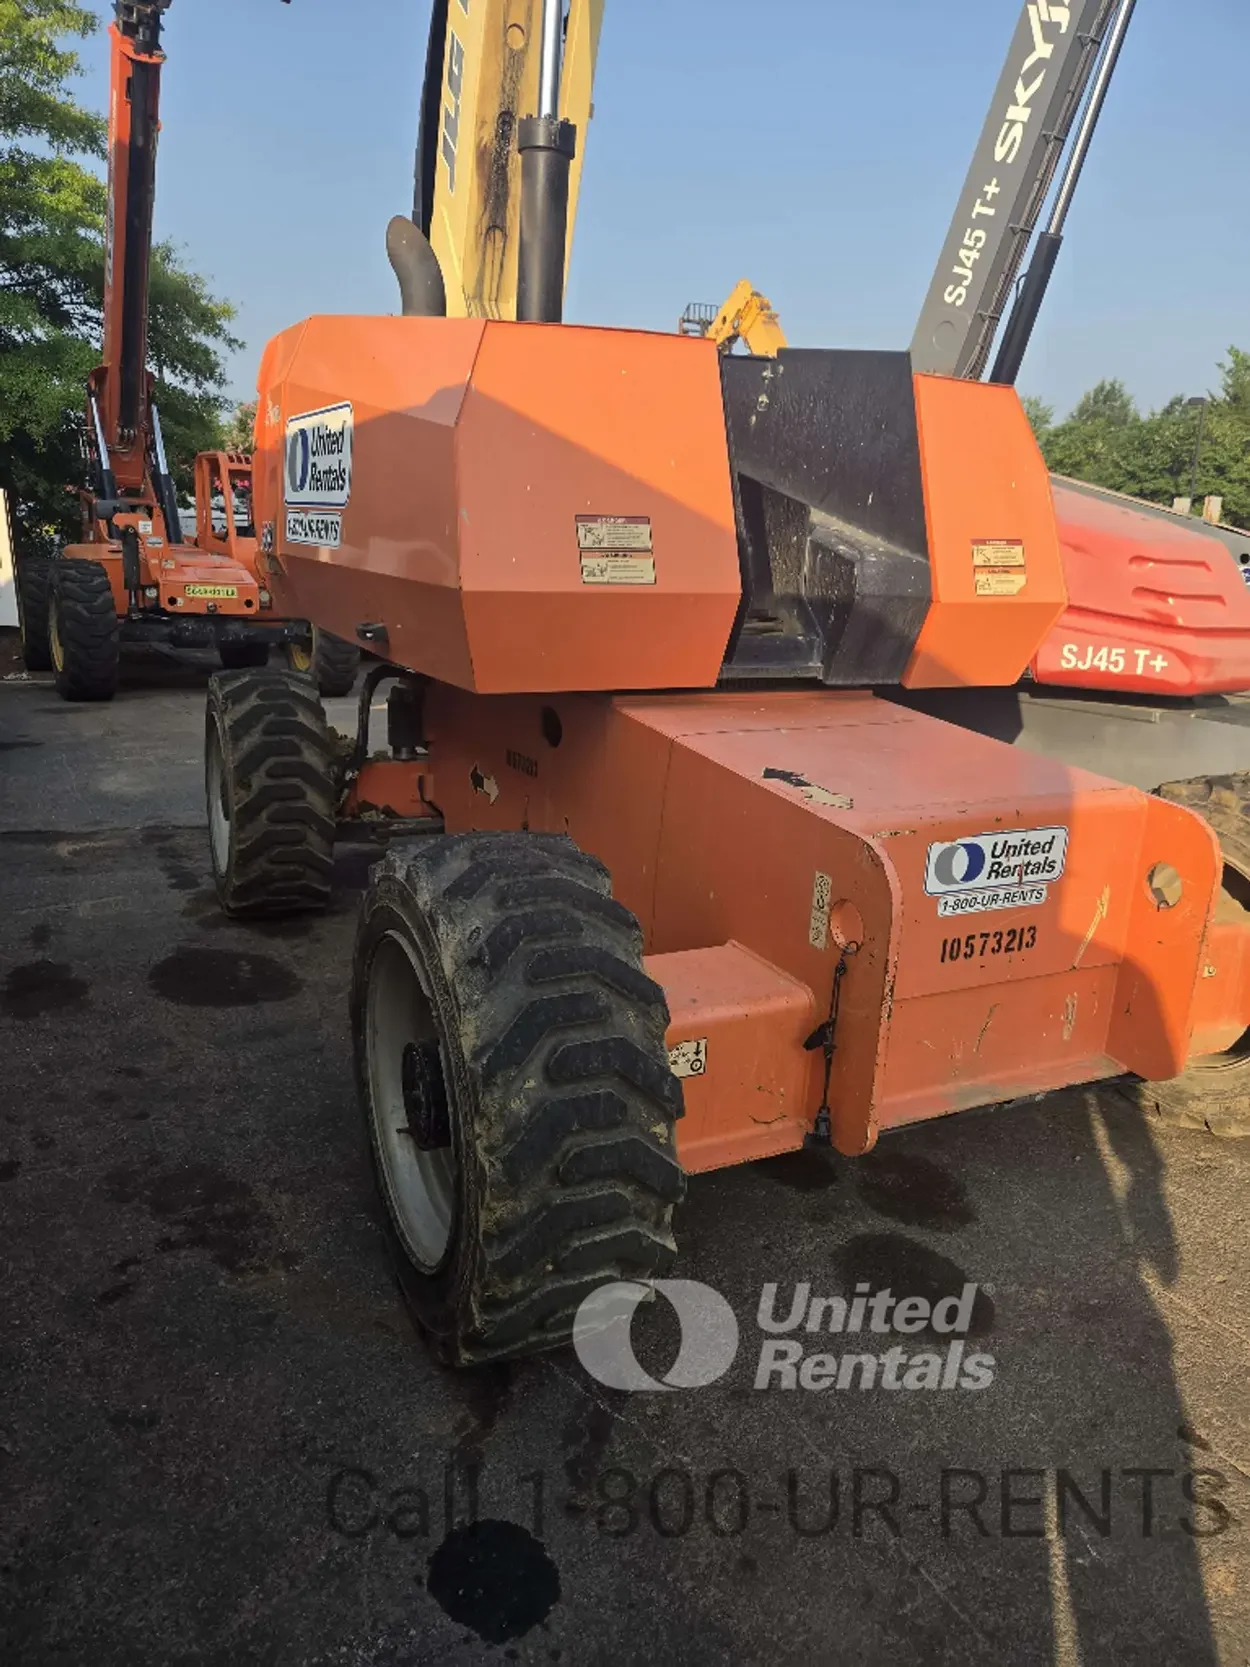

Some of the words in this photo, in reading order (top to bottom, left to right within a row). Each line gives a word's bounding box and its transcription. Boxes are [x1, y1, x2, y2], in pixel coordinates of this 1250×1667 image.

[440, 27, 464, 196] JLG
[943, 227, 987, 306] SJ45
[972, 177, 1001, 219] T+
[994, 0, 1071, 164] SKYJ
[310, 420, 347, 457] United
[308, 459, 347, 492] Rentals
[1060, 643, 1126, 673] SJ45
[1133, 648, 1169, 676] T+
[991, 835, 1056, 859] United
[986, 856, 1057, 880] Rentals
[942, 888, 1044, 912] 1-800-UR-RENTS
[940, 925, 1037, 963] 10573213
